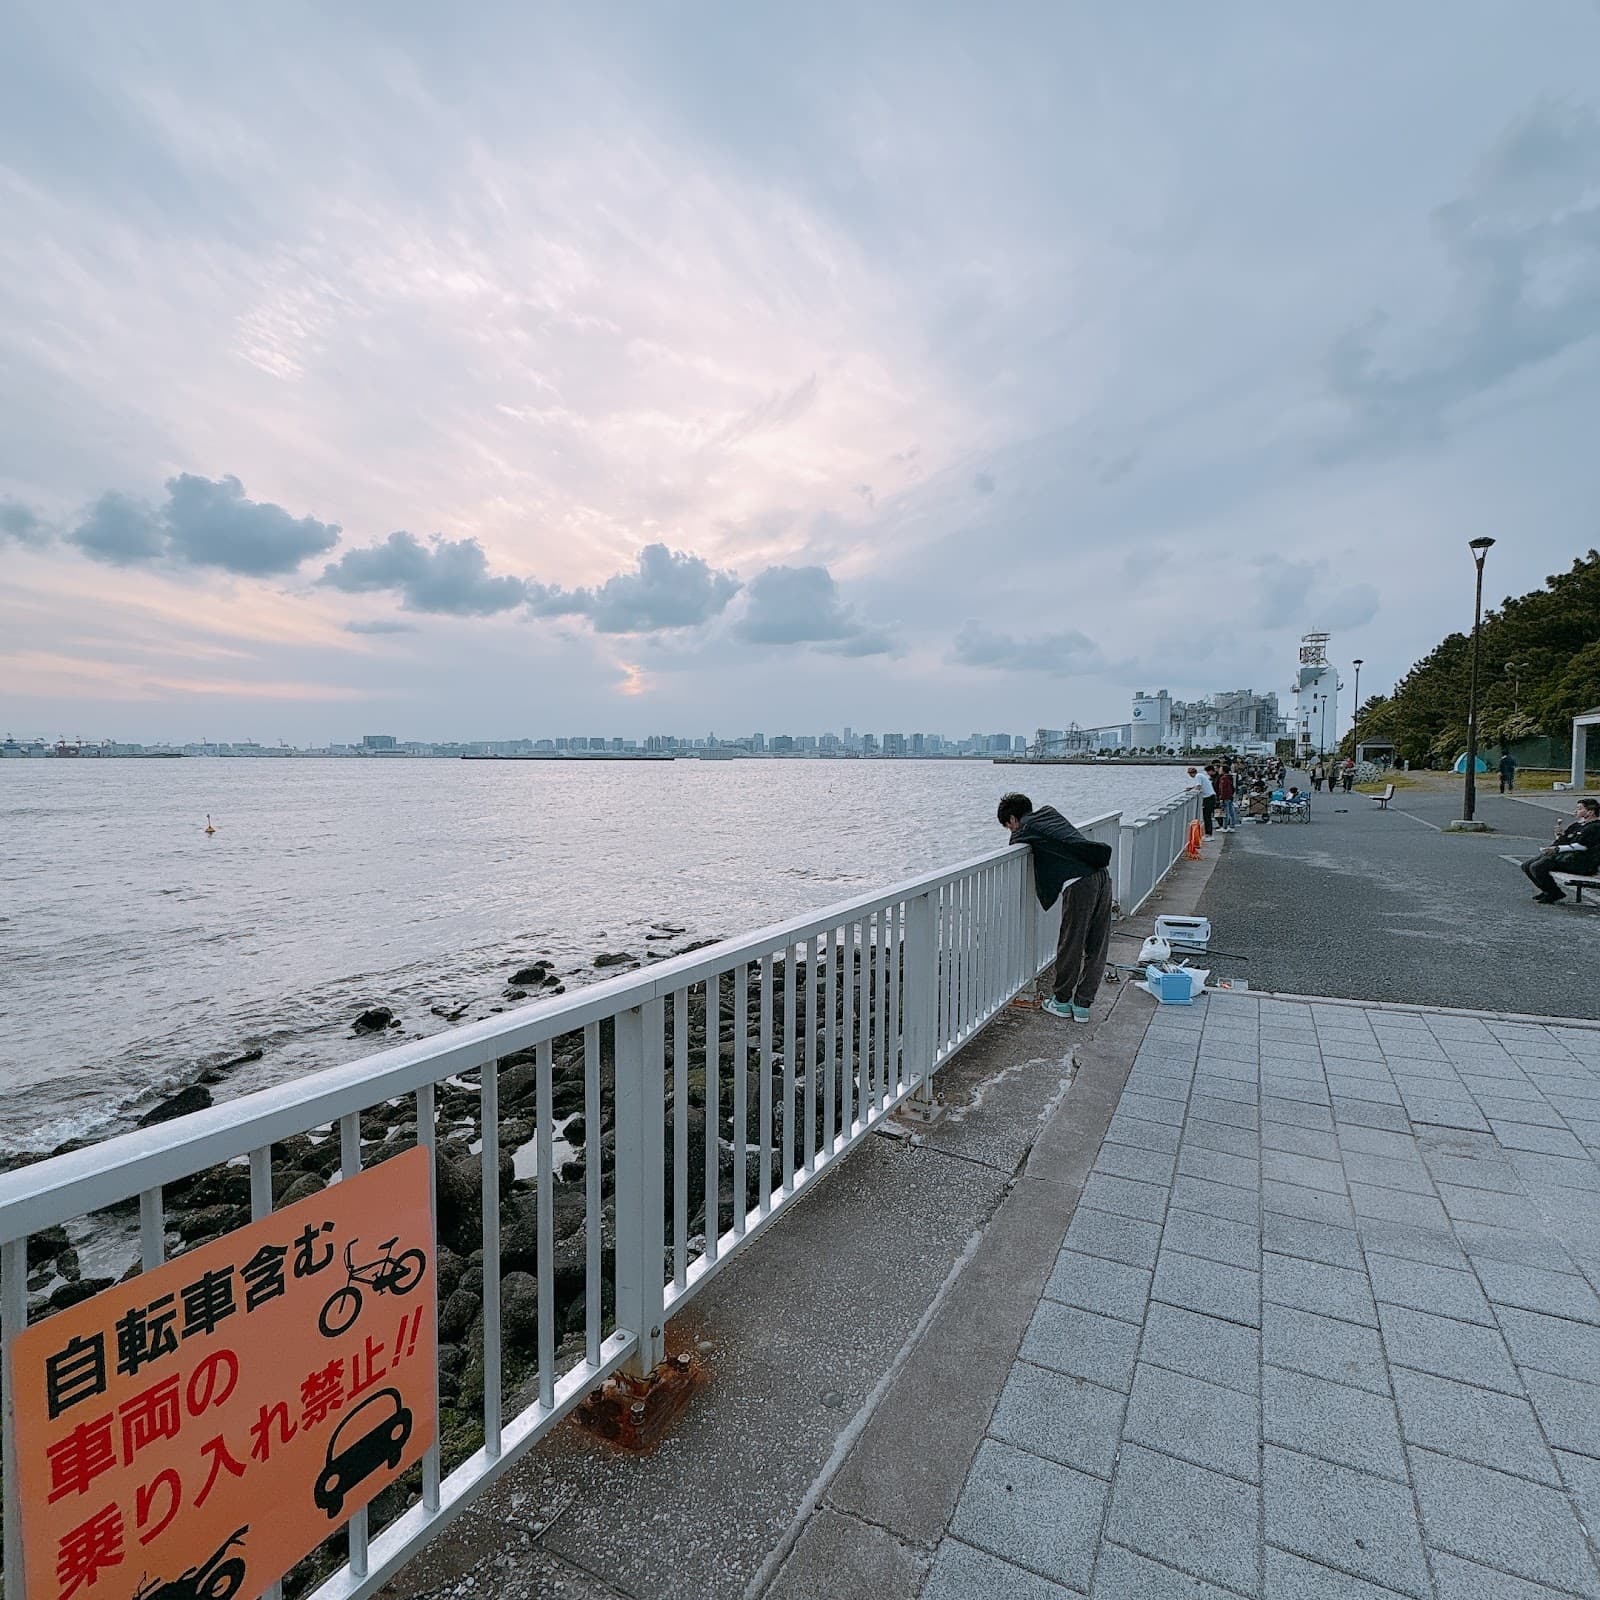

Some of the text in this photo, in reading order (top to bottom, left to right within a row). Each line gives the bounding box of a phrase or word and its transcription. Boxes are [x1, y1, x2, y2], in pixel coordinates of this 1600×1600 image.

[46, 1221, 336, 1421] 自転車含む
[47, 1349, 239, 1505] 車両の
[56, 1305, 424, 1600] 乗り入れ禁止!!
